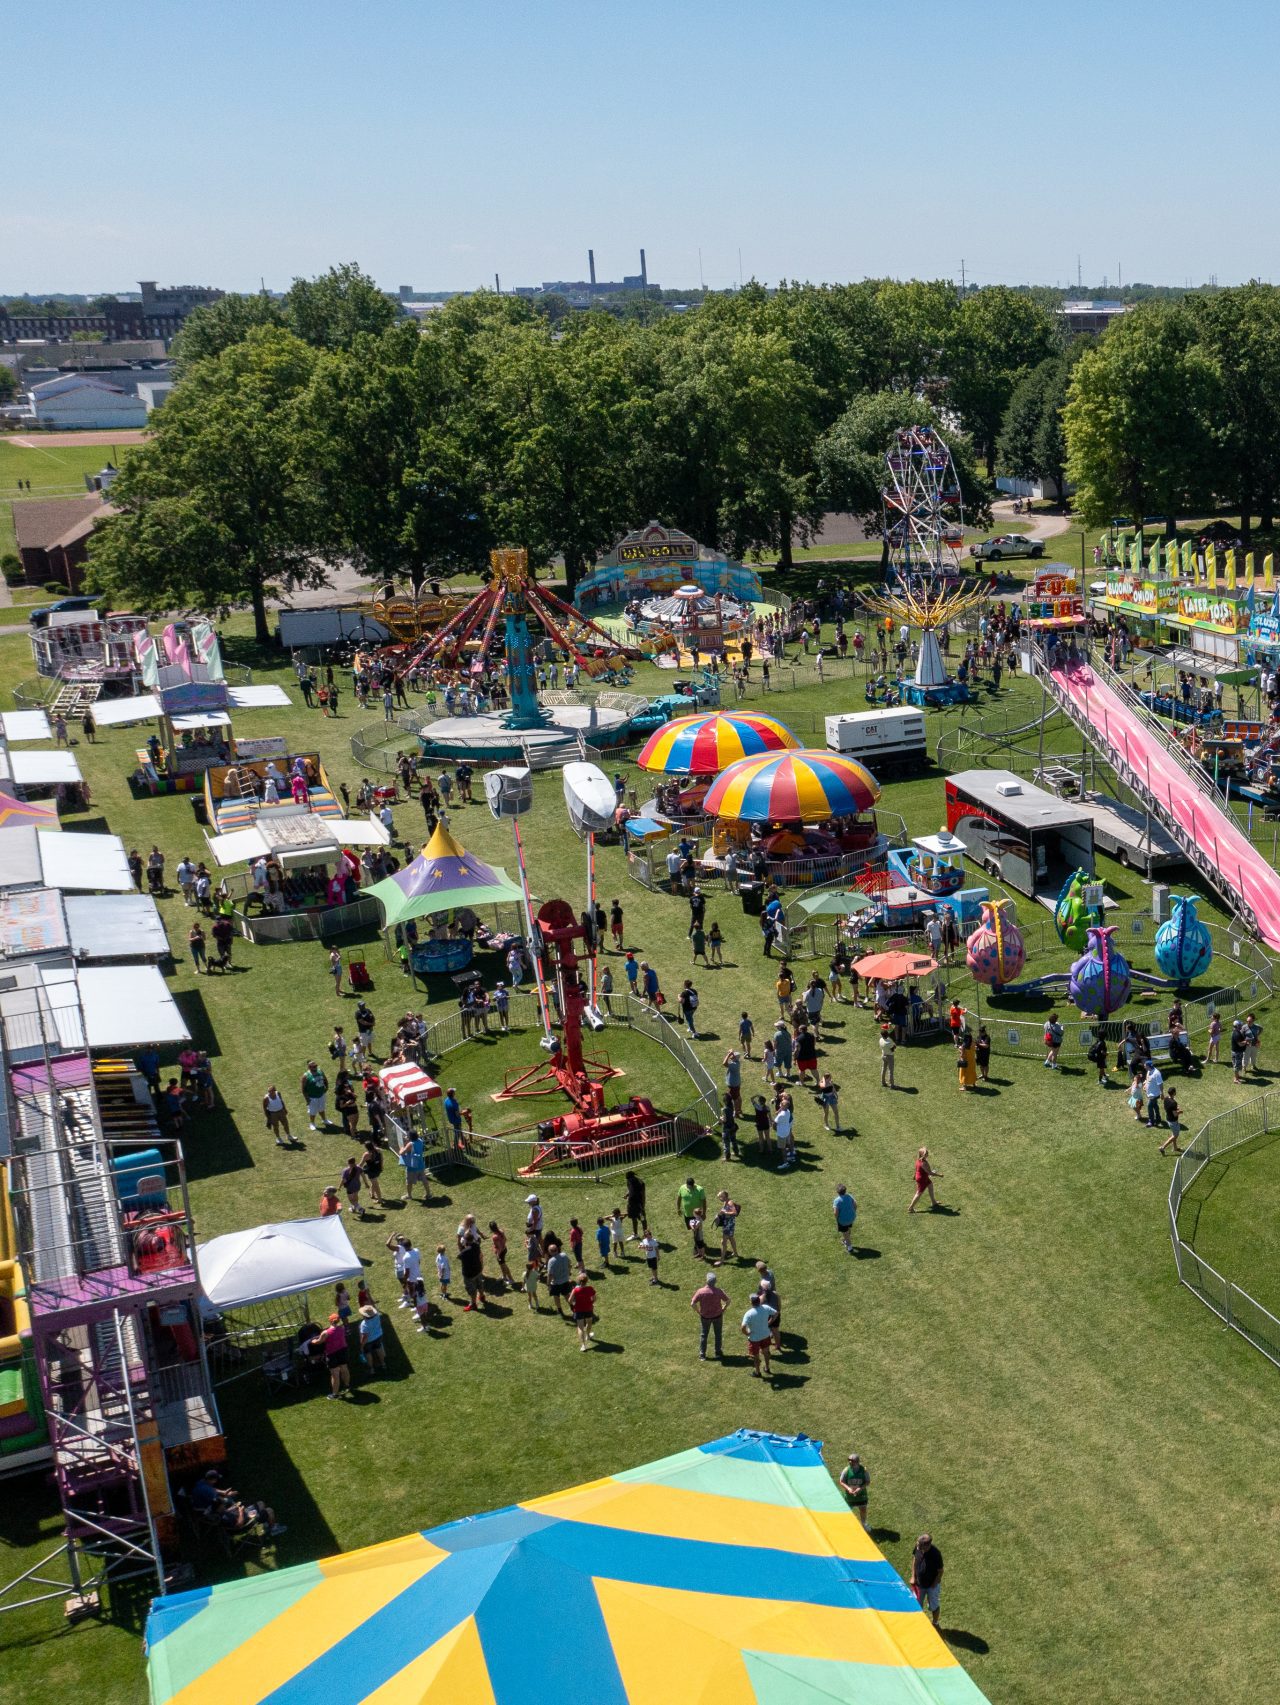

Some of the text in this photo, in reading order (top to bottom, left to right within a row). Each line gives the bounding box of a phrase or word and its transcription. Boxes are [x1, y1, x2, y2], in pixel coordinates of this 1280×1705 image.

[1133, 590, 1155, 602] ONION
[1183, 597, 1229, 620] TATER TOTS
[865, 725, 878, 734] CAT
